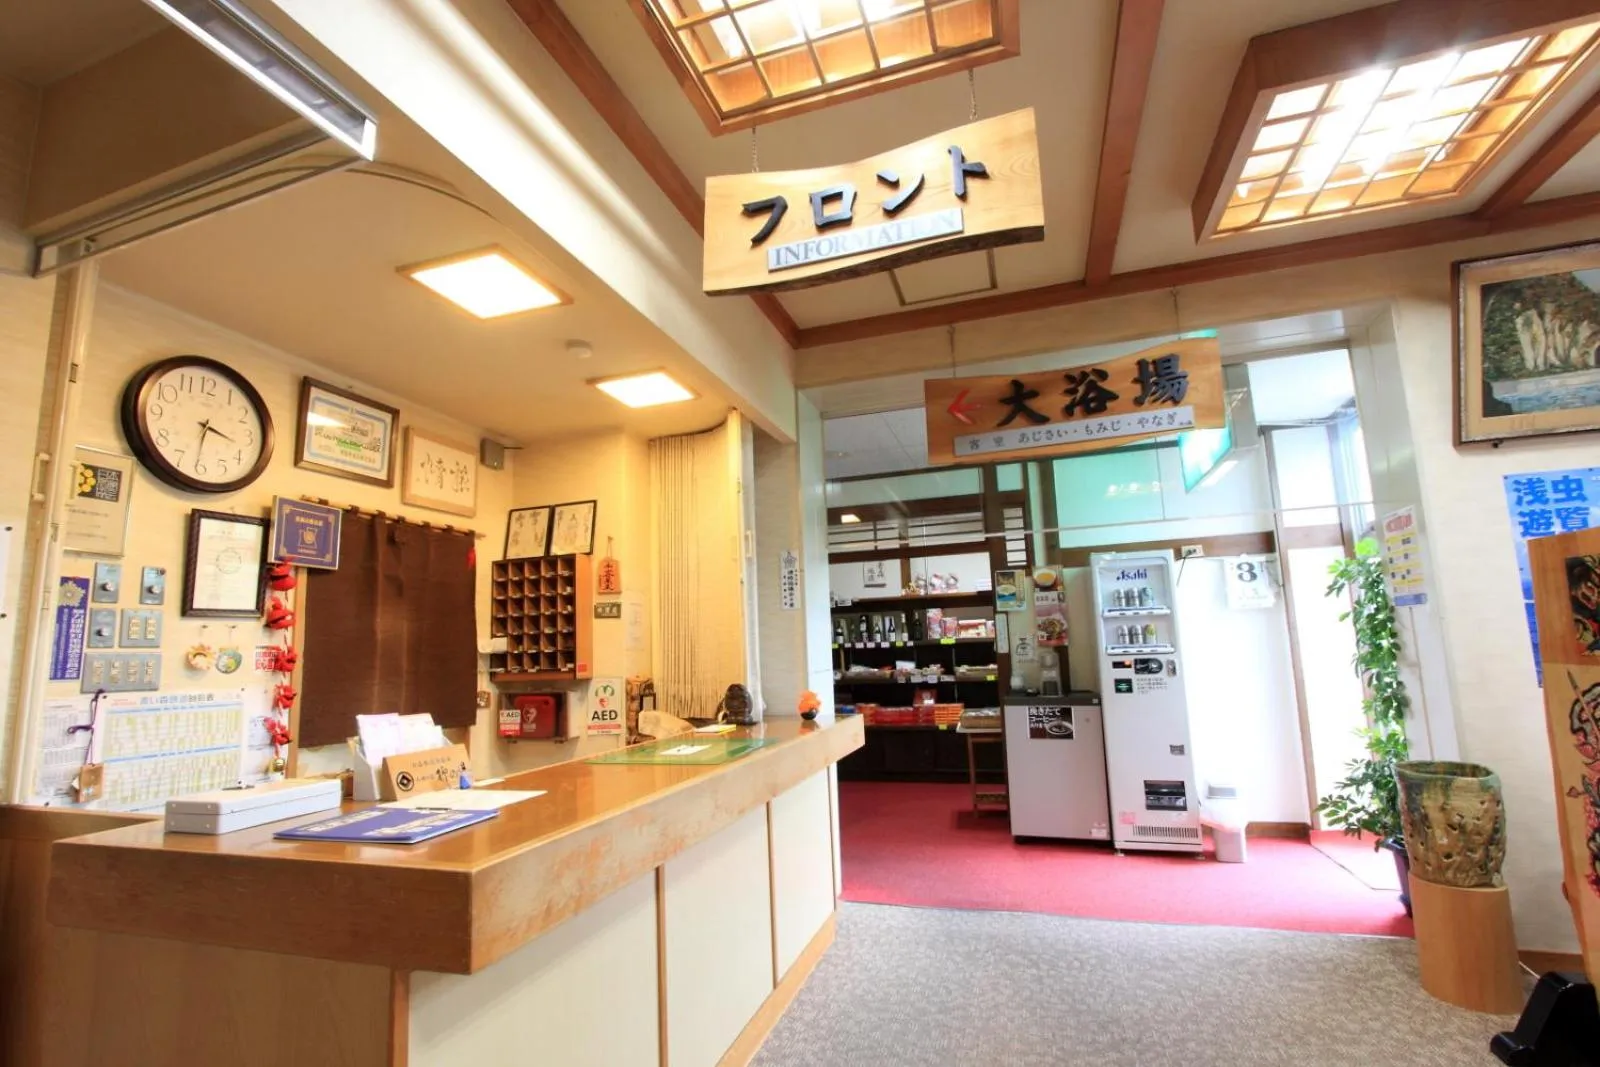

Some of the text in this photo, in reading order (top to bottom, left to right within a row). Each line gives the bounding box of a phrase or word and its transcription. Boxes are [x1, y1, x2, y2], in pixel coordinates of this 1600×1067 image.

[741, 144, 990, 249] フロント
[773, 210, 957, 267] INFORMATION
[158, 382, 178, 404] 10
[179, 374, 194, 394] 11
[200, 375, 217, 397] 12
[996, 352, 1190, 428] 大浴場
[226, 388, 233, 406] 1
[150, 405, 163, 421] 9
[237, 407, 249, 425] 2
[155, 428, 170, 448] 8
[243, 428, 254, 448] 3
[174, 449, 186, 468] 7
[194, 456, 208, 476] 6
[233, 448, 244, 466] 4
[216, 458, 229, 477] 5
[1512, 475, 1588, 506] 浅虫
[1517, 506, 1590, 537] 遊覧
[1116, 568, 1148, 581] Asahi
[1236, 561, 1258, 583] 3
[591, 709, 619, 722] AED
